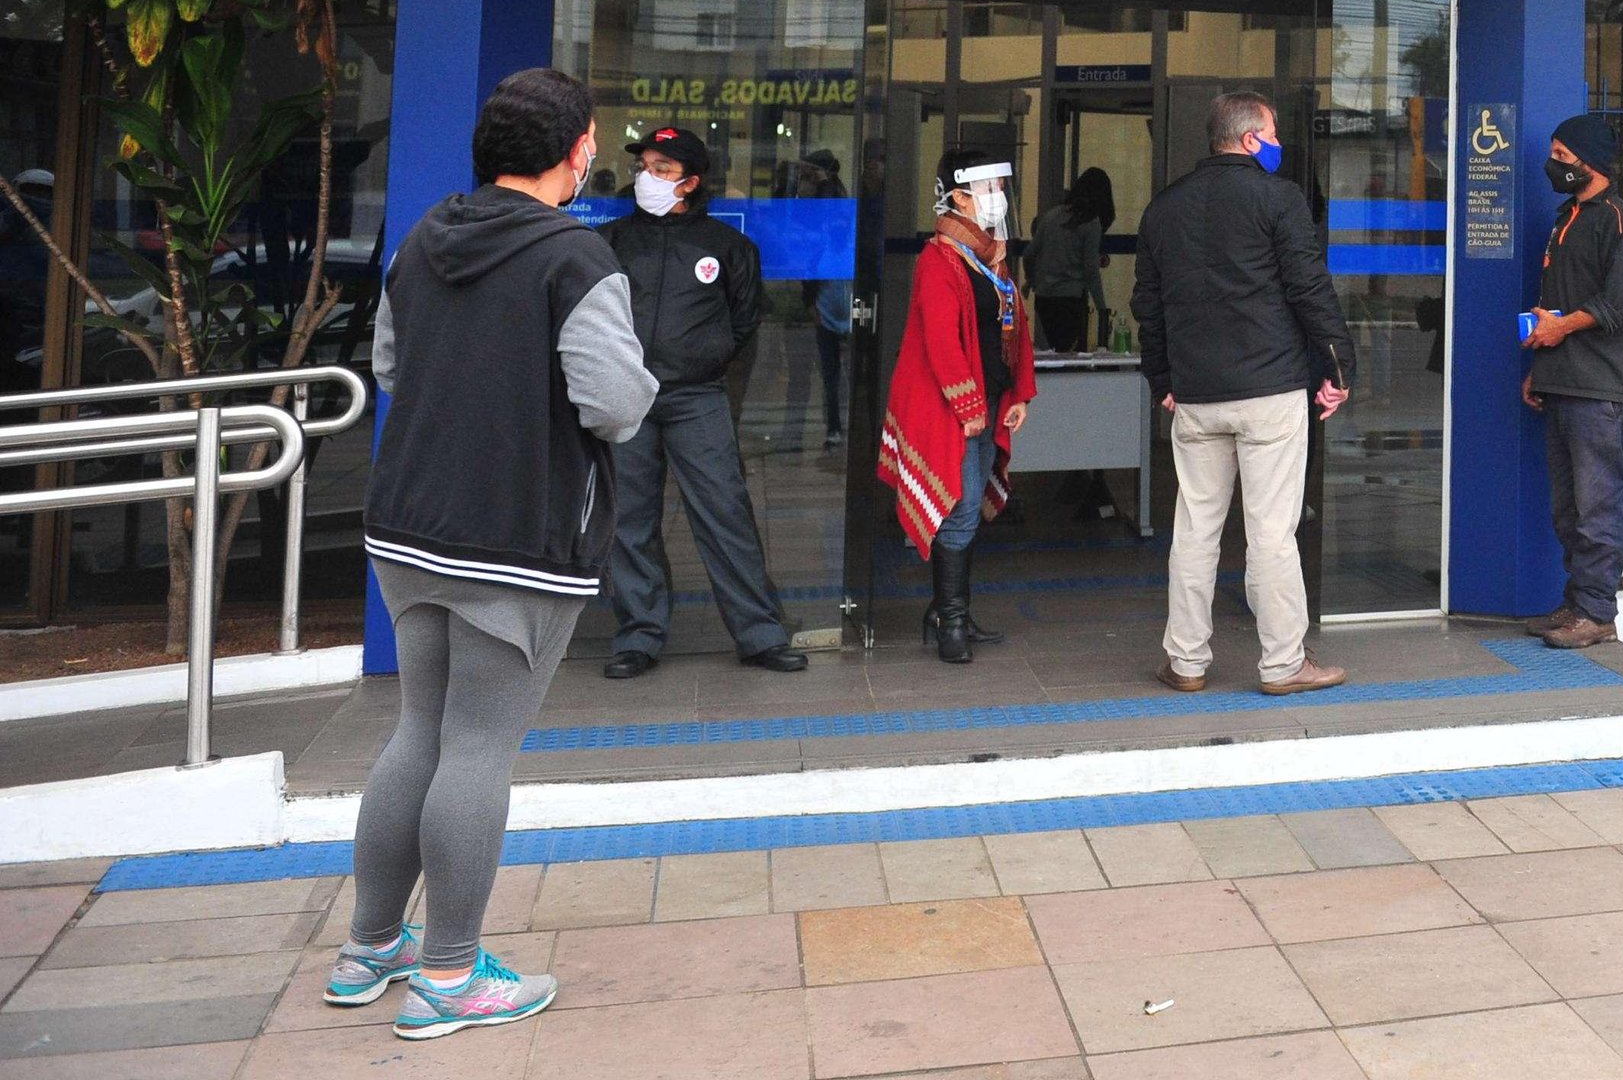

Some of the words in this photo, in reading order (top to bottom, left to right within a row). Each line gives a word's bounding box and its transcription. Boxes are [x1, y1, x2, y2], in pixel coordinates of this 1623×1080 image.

[1078, 67, 1127, 81] Entrada
[1468, 164, 1511, 172] ECONÔMICA
[557, 202, 592, 212] ntrada
